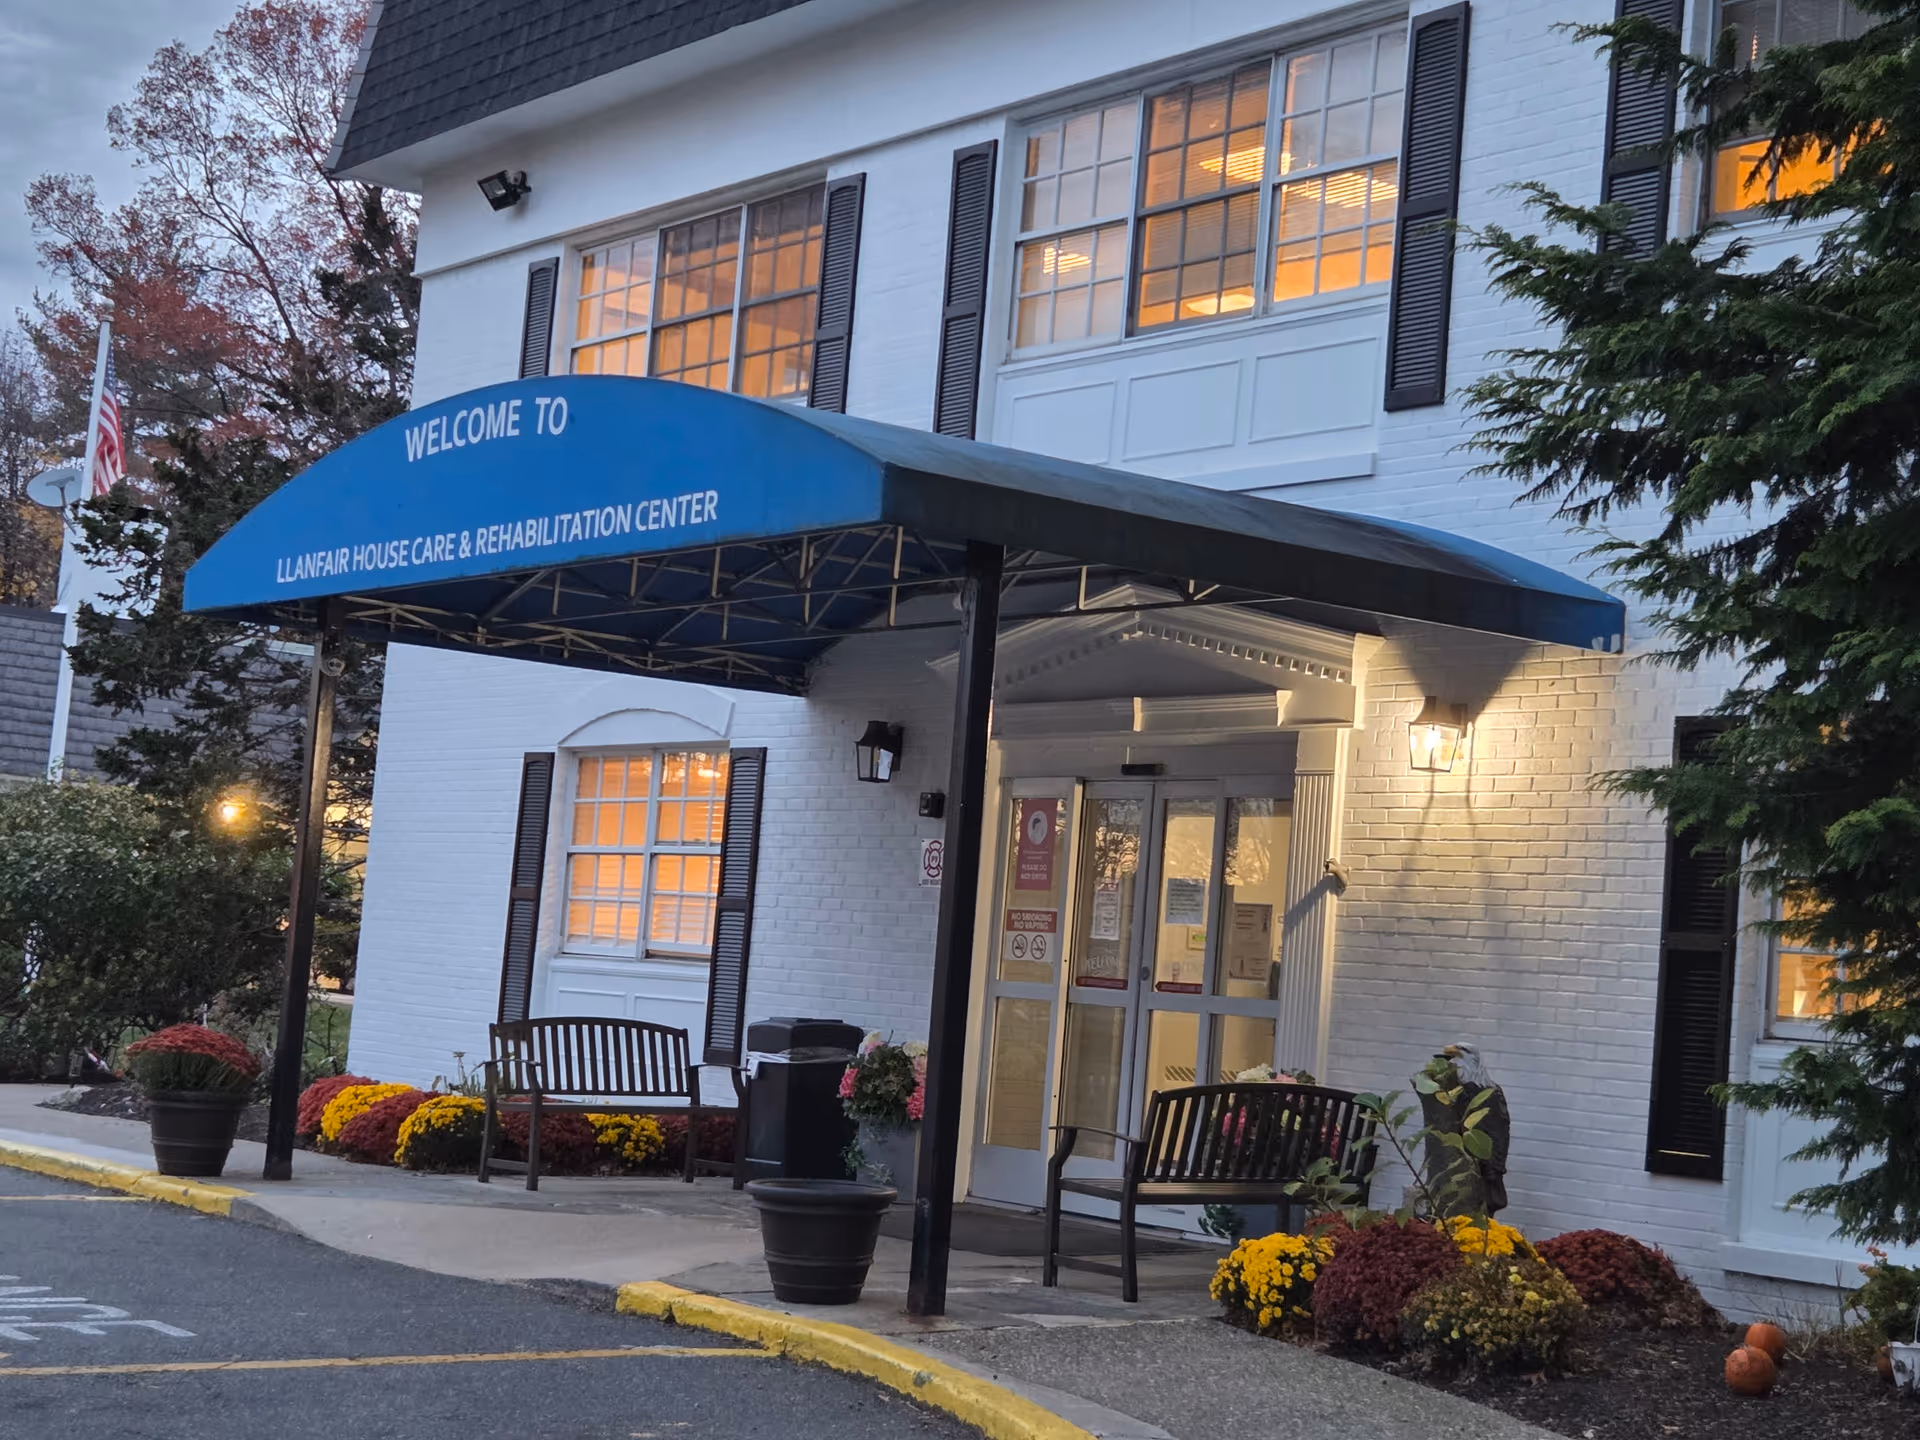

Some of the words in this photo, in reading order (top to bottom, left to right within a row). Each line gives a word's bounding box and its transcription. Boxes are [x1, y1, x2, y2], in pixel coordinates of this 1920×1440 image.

[405, 399, 522, 462] WELCOME
[535, 396, 568, 435] TO
[276, 547, 350, 583] LLANFAIR
[352, 540, 410, 571] HOUSE
[411, 533, 457, 565] CARE
[459, 530, 472, 559] &
[475, 503, 632, 556] REHABILITATION
[635, 489, 719, 532] CENTER
[1011, 912, 1021, 920] NO
[1022, 912, 1052, 922] SMOKING
[1013, 920, 1024, 929] NO
[1025, 920, 1049, 930] VAPING
